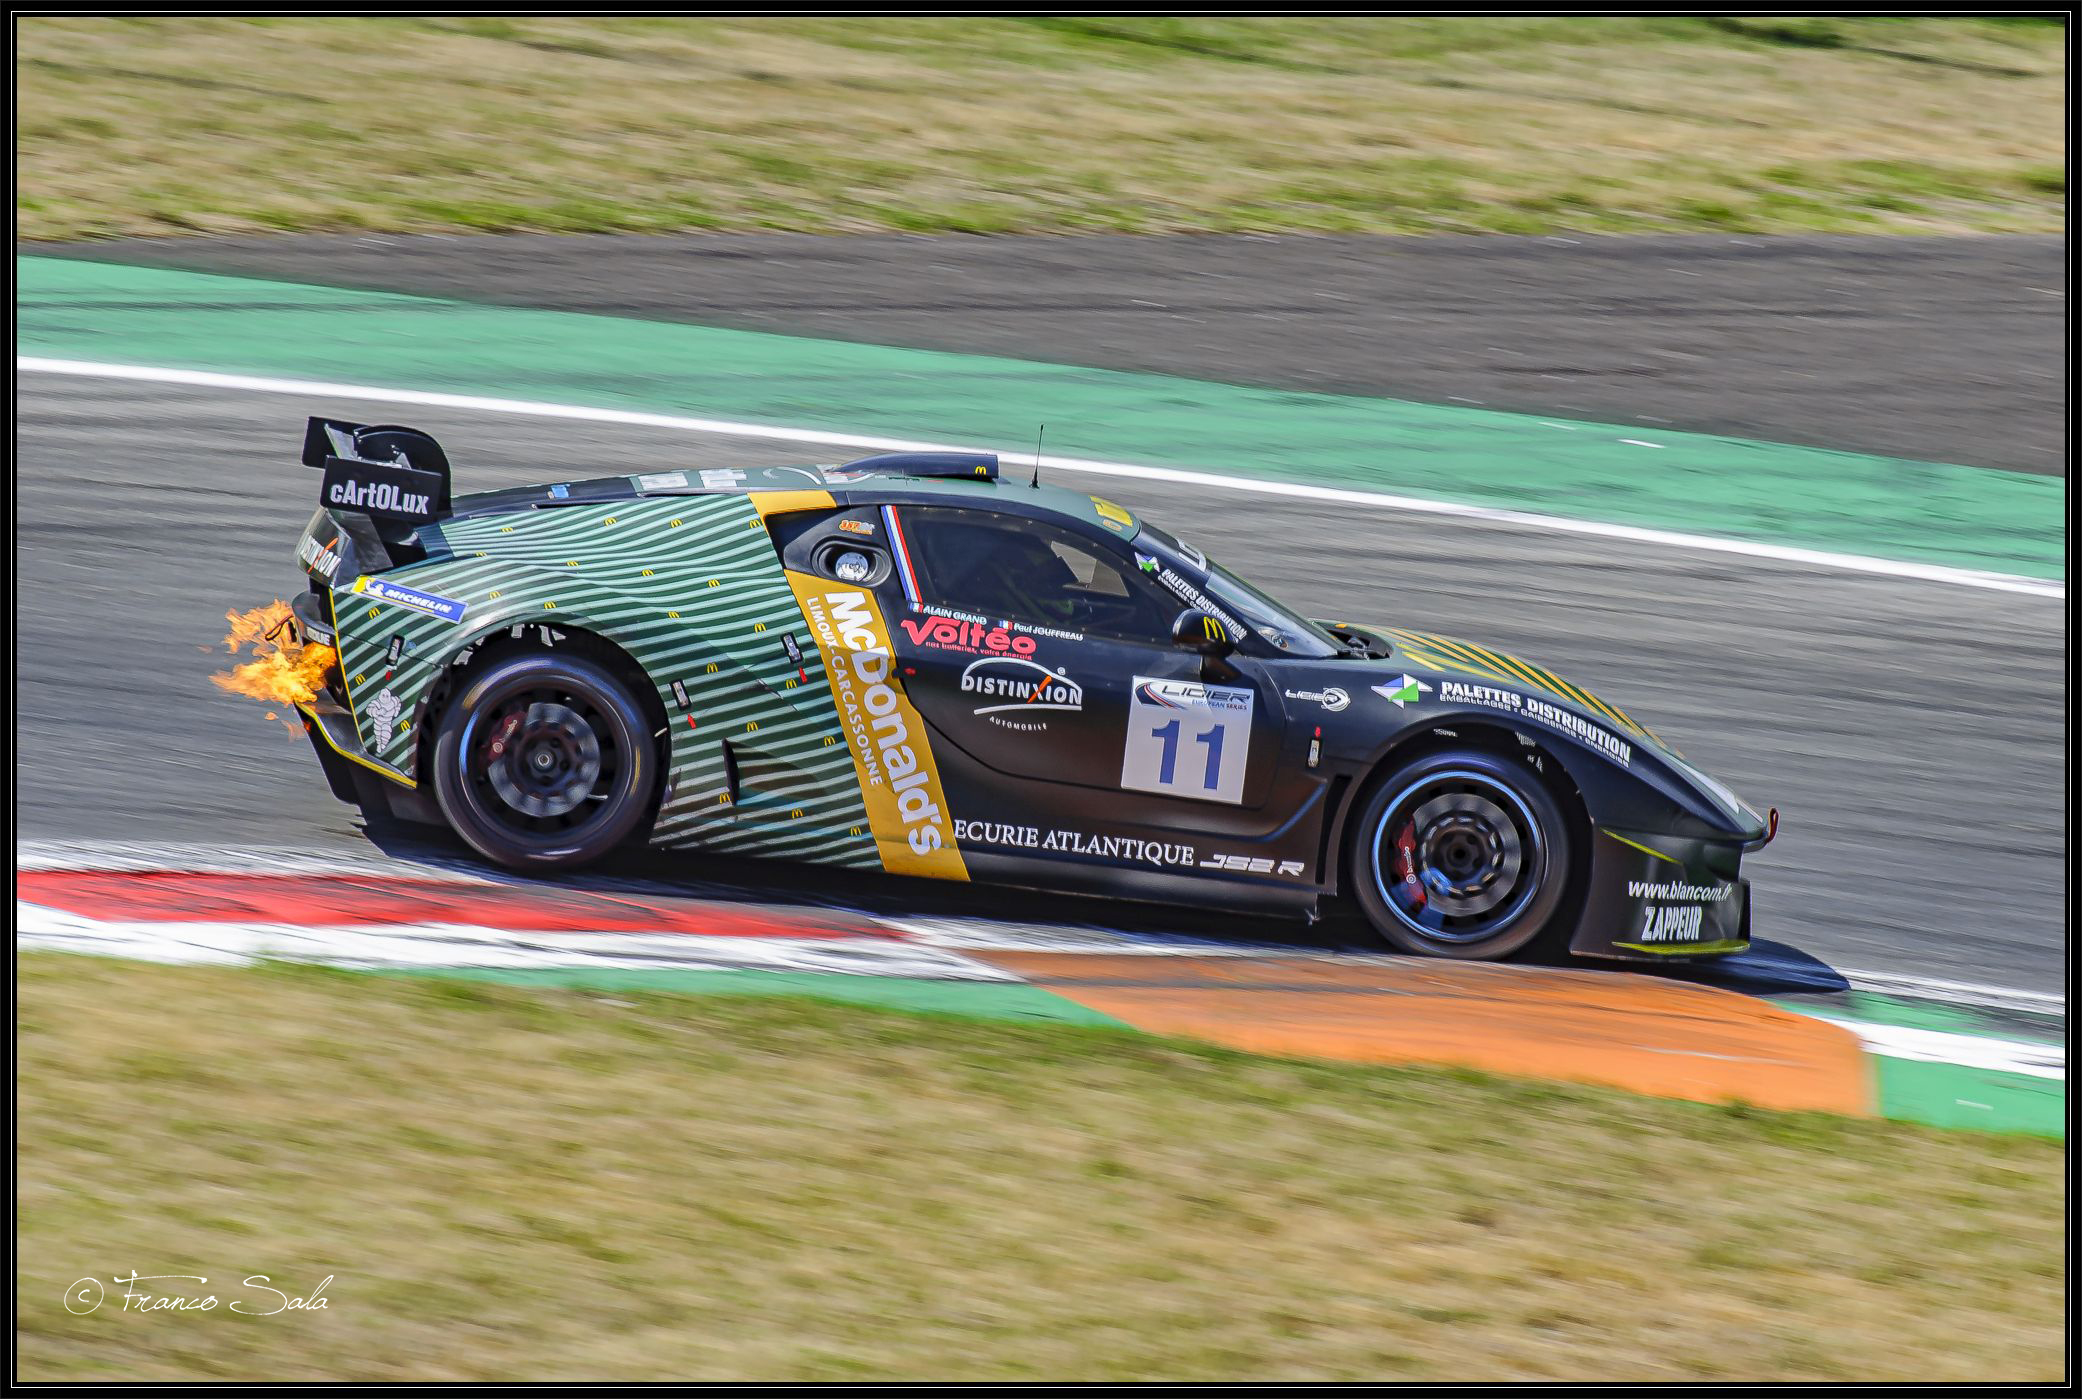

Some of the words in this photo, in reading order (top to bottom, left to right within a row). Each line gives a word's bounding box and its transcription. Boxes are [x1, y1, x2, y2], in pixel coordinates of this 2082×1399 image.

[330, 480, 429, 515] cArtOLux
[385, 589, 453, 613] MICHELIN
[923, 605, 952, 619] ALAIN
[953, 611, 987, 625] GRAND
[1161, 568, 1200, 600] PALETTES
[1196, 595, 1248, 640] DISTRIBUTION
[1014, 622, 1032, 633] Paul
[1033, 626, 1084, 641] JOUFFREAU
[961, 674, 1082, 705] DISTINXION
[1162, 685, 1251, 704] LIGIER
[824, 591, 943, 856] McDonald's
[989, 715, 1048, 732] AUTOMOBILE
[1441, 681, 1521, 708] PALETTES
[1527, 698, 1631, 762] DISTRIBUTION
[1151, 719, 1225, 791] 11
[954, 819, 1039, 848] ECURIE
[1042, 829, 1194, 867] ATLANTIQUE
[1277, 860, 1305, 877] R
[1628, 880, 1733, 902] www.blancom.fr
[1641, 906, 1703, 941] ZAPPEUR
